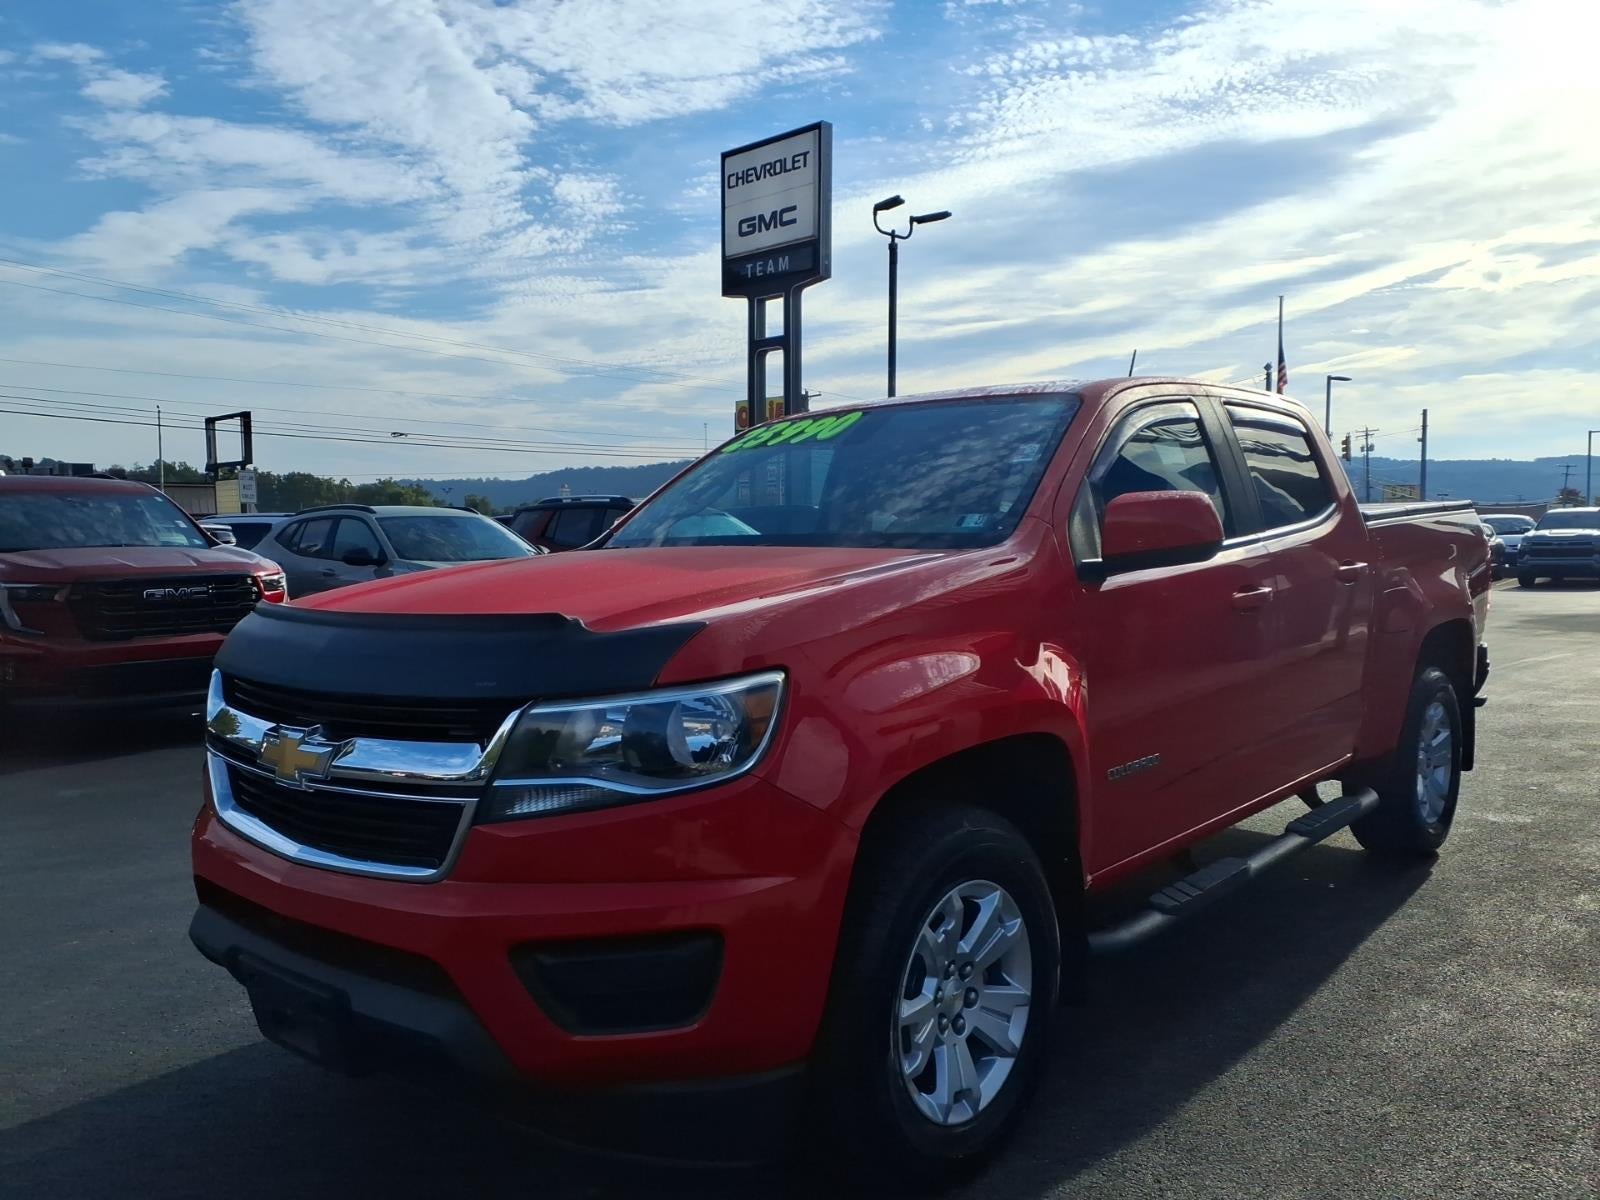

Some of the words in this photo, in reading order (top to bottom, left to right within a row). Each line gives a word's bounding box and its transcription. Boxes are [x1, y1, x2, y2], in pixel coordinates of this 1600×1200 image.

[727, 150, 810, 190] CHEVROLET
[737, 204, 798, 238] GMC
[745, 255, 790, 279] TEAM
[143, 586, 209, 601] GMC
[1107, 752, 1161, 780] COLORADO
